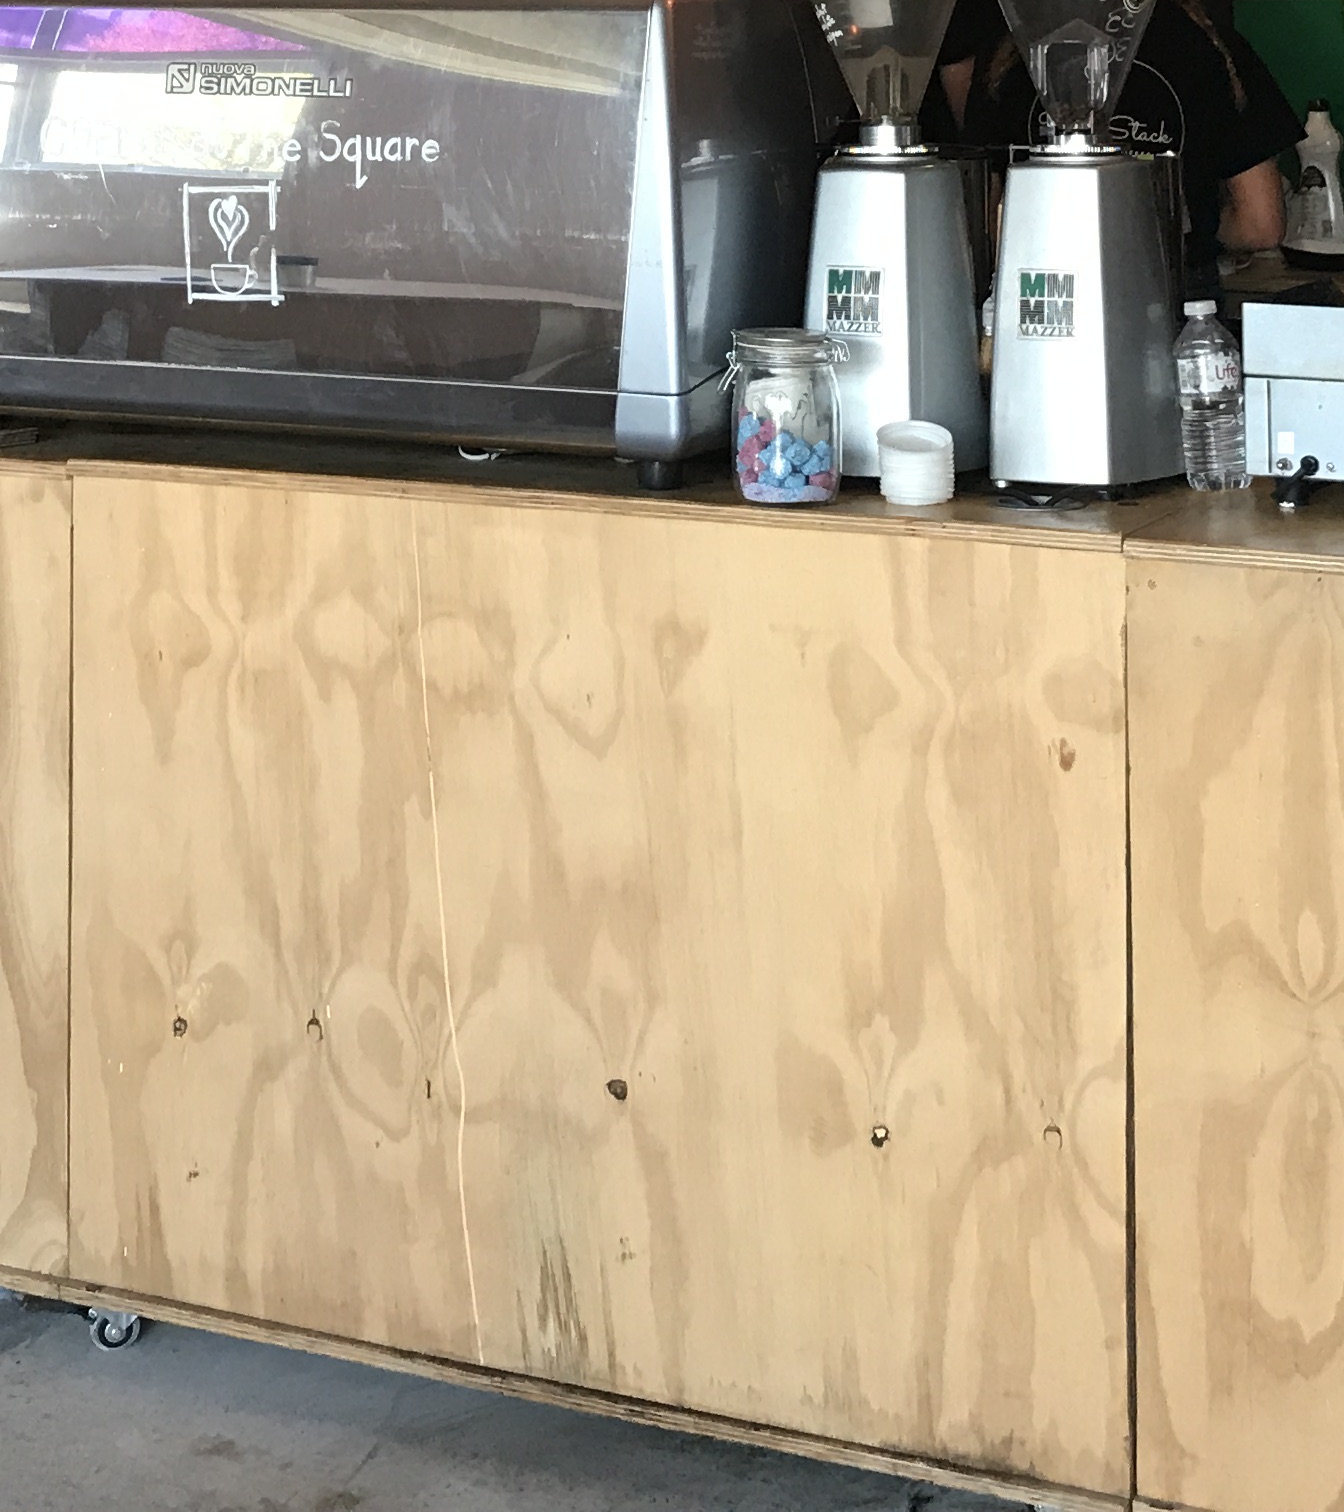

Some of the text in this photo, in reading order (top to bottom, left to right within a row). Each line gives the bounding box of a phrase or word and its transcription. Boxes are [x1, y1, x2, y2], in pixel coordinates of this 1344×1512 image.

[201, 63, 256, 76] nuova
[200, 75, 353, 98] SIMONELLI
[1109, 115, 1174, 144] Stack
[319, 120, 441, 189] Square
[825, 319, 882, 334] MAZZER
[1018, 324, 1076, 338] MAZZER
